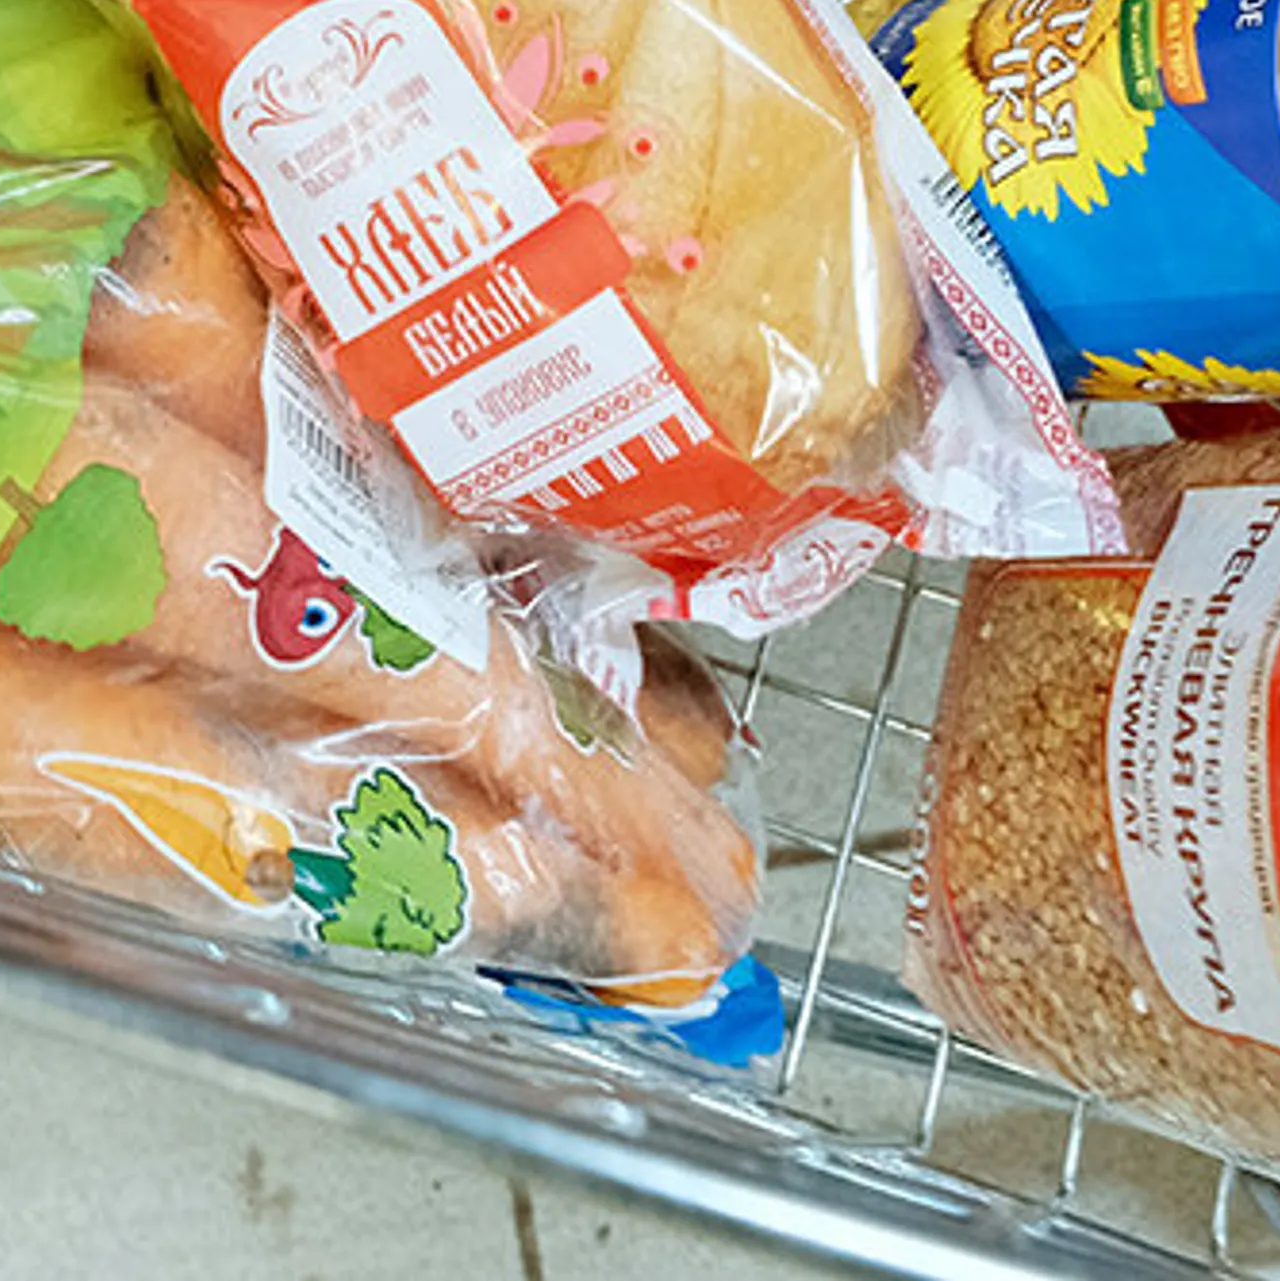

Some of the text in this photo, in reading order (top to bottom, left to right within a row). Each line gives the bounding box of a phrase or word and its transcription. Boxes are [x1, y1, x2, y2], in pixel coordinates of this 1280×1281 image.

[318, 146, 514, 315] ХЛЕБ
[402, 260, 548, 379] БЕЛЫЙ
[1118, 600, 1173, 844] BUCKWHEAT
[1172, 807, 1237, 1014] КРУПА
